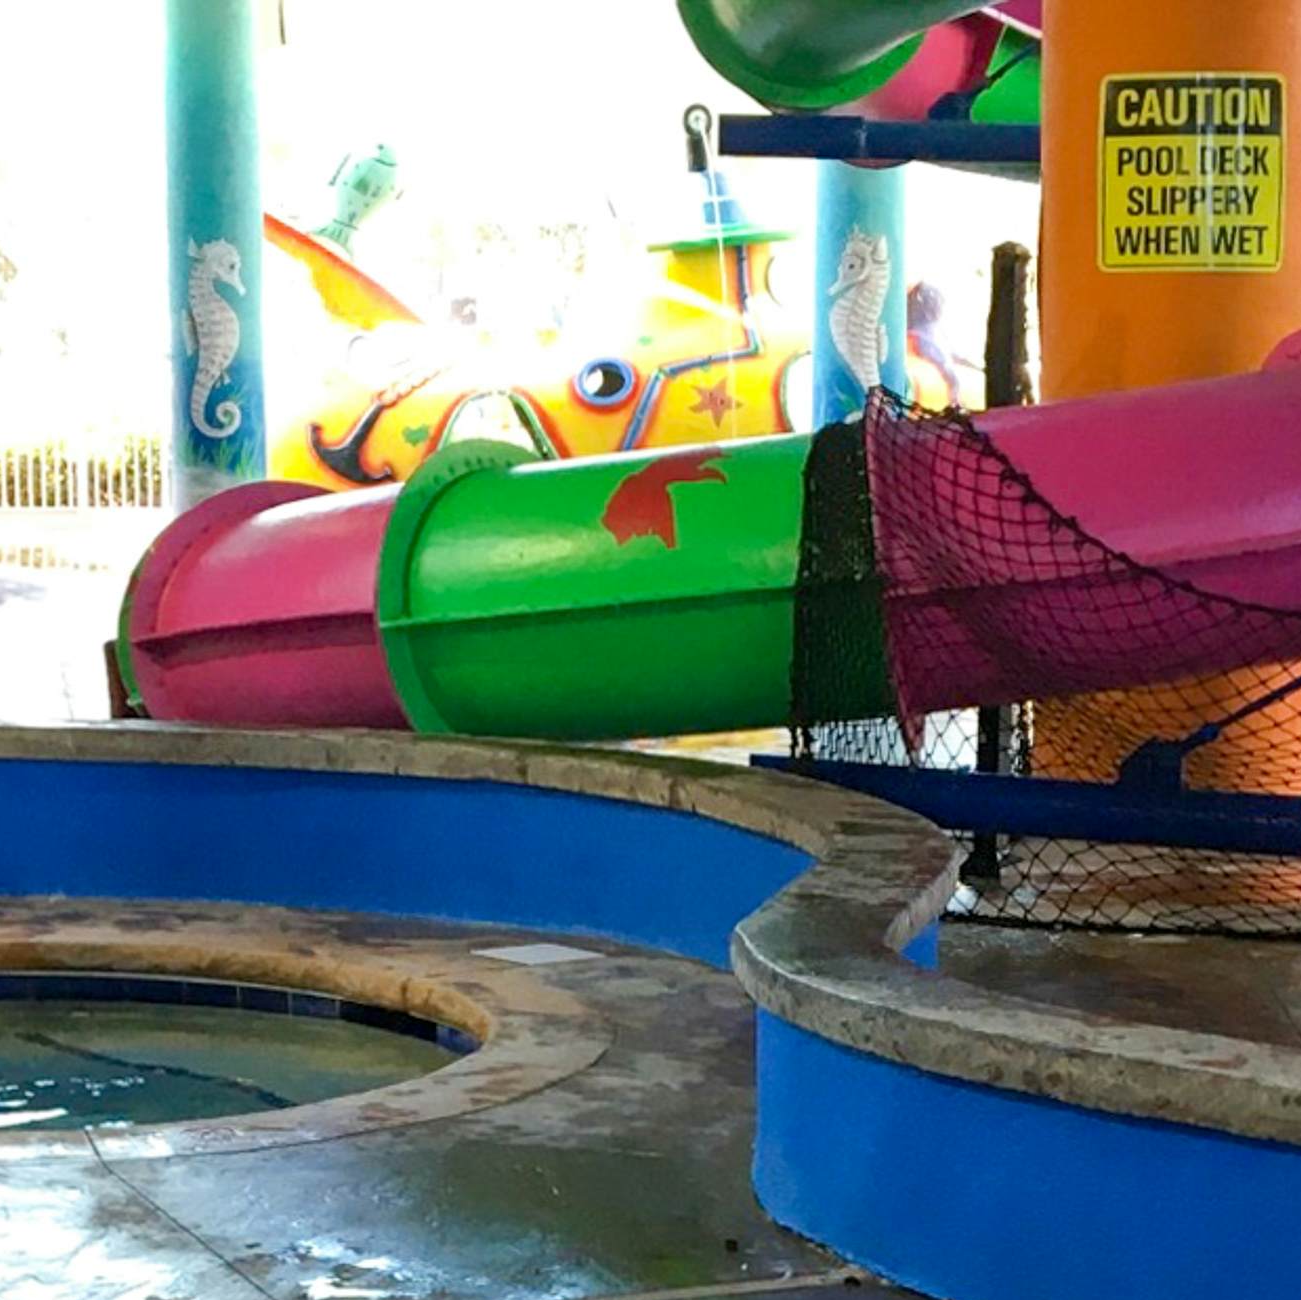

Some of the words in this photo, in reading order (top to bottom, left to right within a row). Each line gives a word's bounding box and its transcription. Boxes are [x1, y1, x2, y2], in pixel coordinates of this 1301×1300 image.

[1117, 87, 1271, 127] CAUTION
[1117, 146, 1190, 176] POOL
[1200, 146, 1269, 176] DECK
[1126, 186, 1259, 216] SLIPPERY
[1115, 226, 1200, 256] WHEN
[1210, 226, 1269, 256] WET
